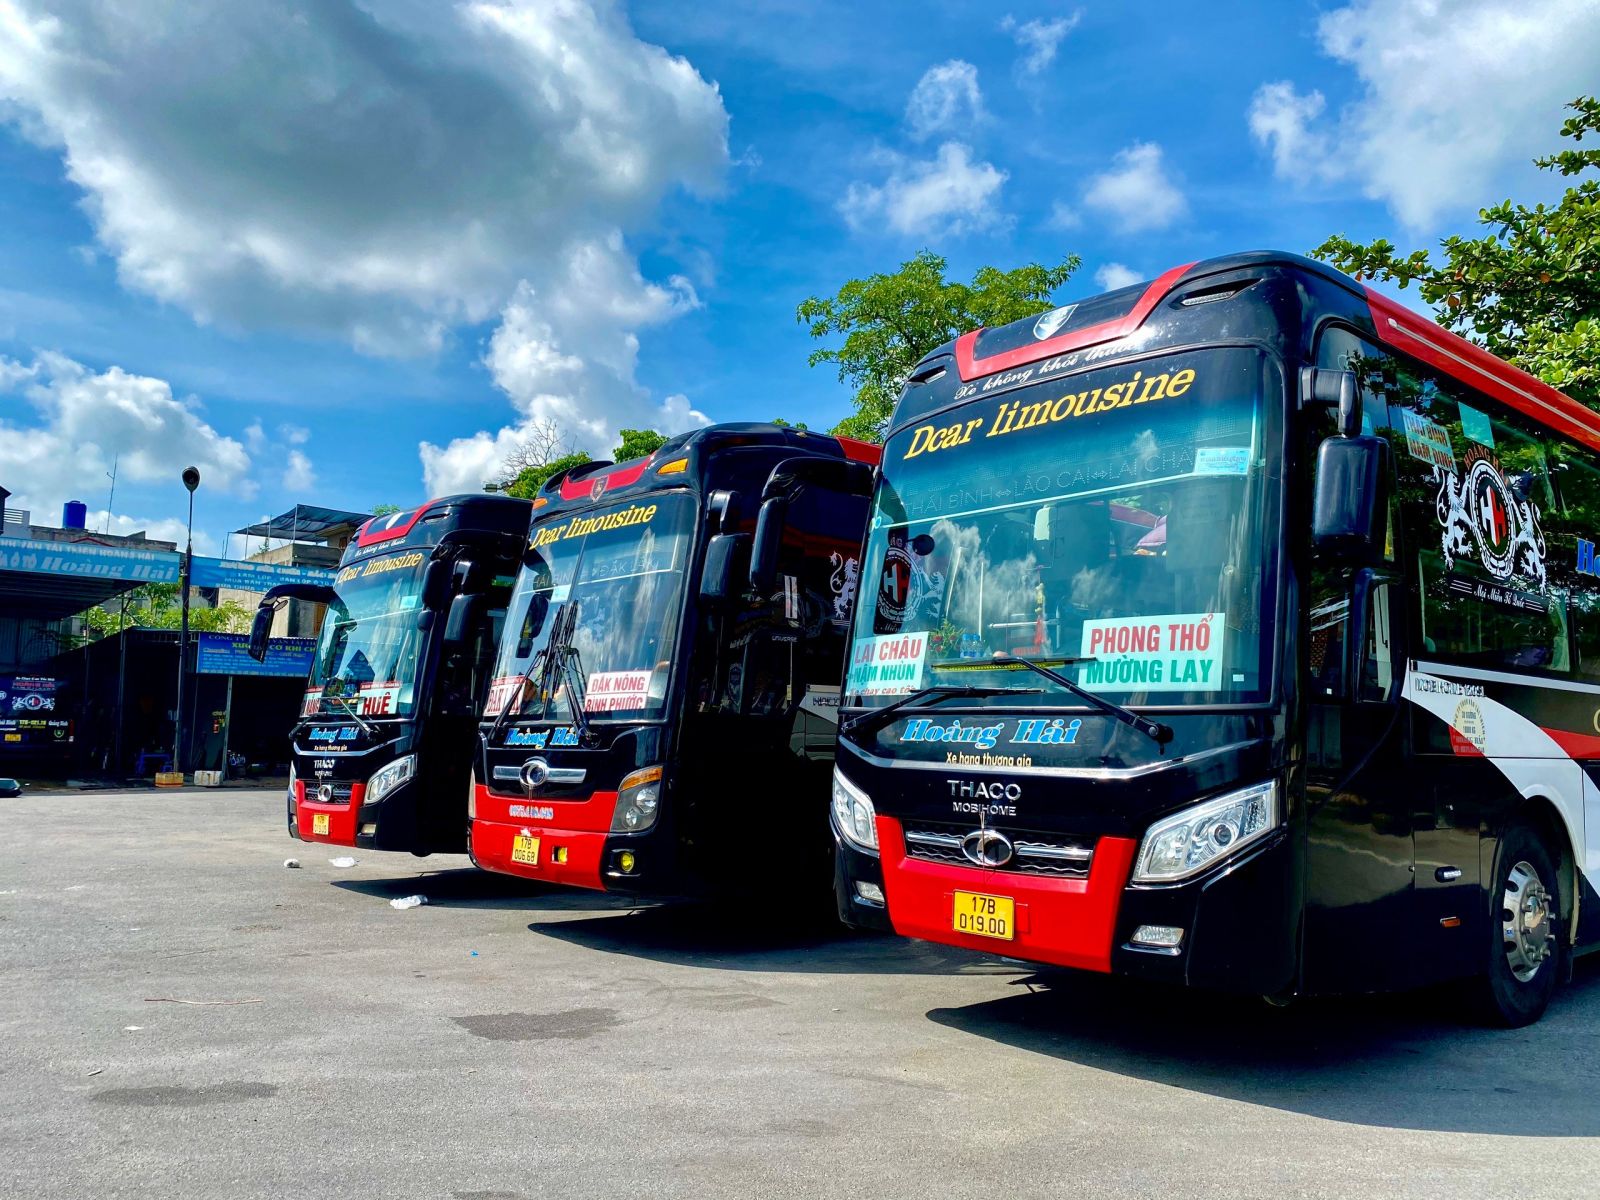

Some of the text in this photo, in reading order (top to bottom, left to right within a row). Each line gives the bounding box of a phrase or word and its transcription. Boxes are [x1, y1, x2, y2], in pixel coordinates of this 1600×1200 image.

[982, 368, 1034, 392] không
[1038, 354, 1079, 375] khói
[903, 368, 1196, 460] Dcar limousine
[1144, 448, 1193, 473] CHÂ
[529, 504, 657, 550] Dcar limousine
[40, 555, 125, 578] Hoàng
[362, 552, 423, 576] limousine
[1090, 613, 1213, 654] PHONG THỔ
[855, 635, 922, 663] LAI CHÂU
[880, 661, 916, 681] NHÙN
[1086, 655, 1213, 684] MƯỜNG LAY
[614, 674, 646, 691] NÔNG
[503, 727, 550, 749] Hoàng
[900, 718, 1082, 749] Hoàng Hải
[946, 751, 958, 763] Xe
[947, 779, 1021, 801] THACO
[953, 802, 1016, 816] MOBIHOME
[972, 896, 996, 915] 17B
[959, 913, 1006, 935] 019.00
